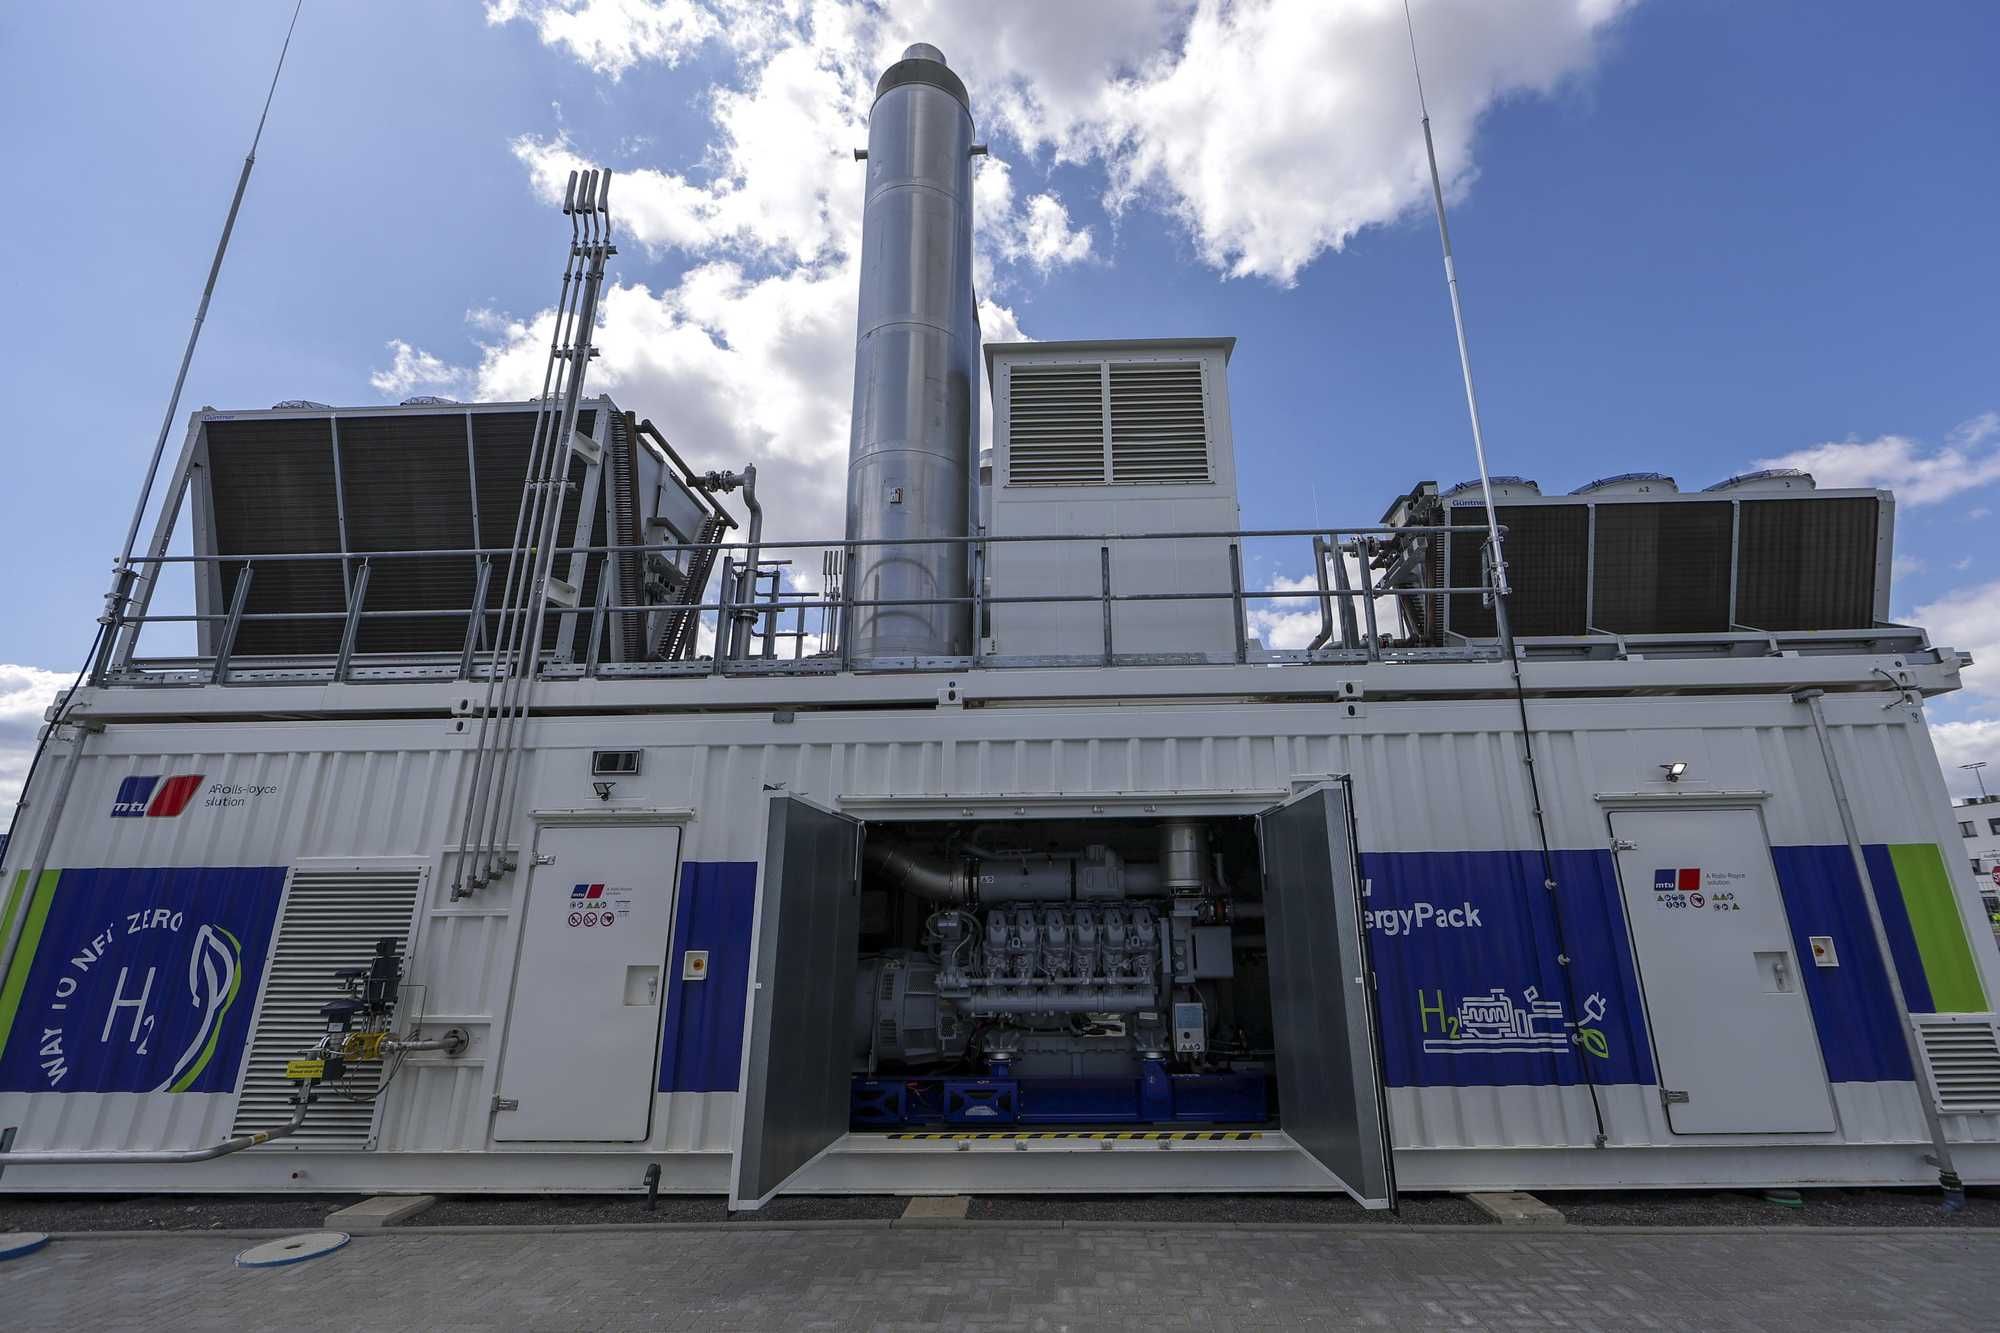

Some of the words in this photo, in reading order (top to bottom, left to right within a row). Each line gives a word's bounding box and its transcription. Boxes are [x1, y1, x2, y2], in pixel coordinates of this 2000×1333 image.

[1655, 881, 1675, 889] mtu
[39, 1028, 68, 1087] WAY
[126, 908, 183, 935] ZERO
